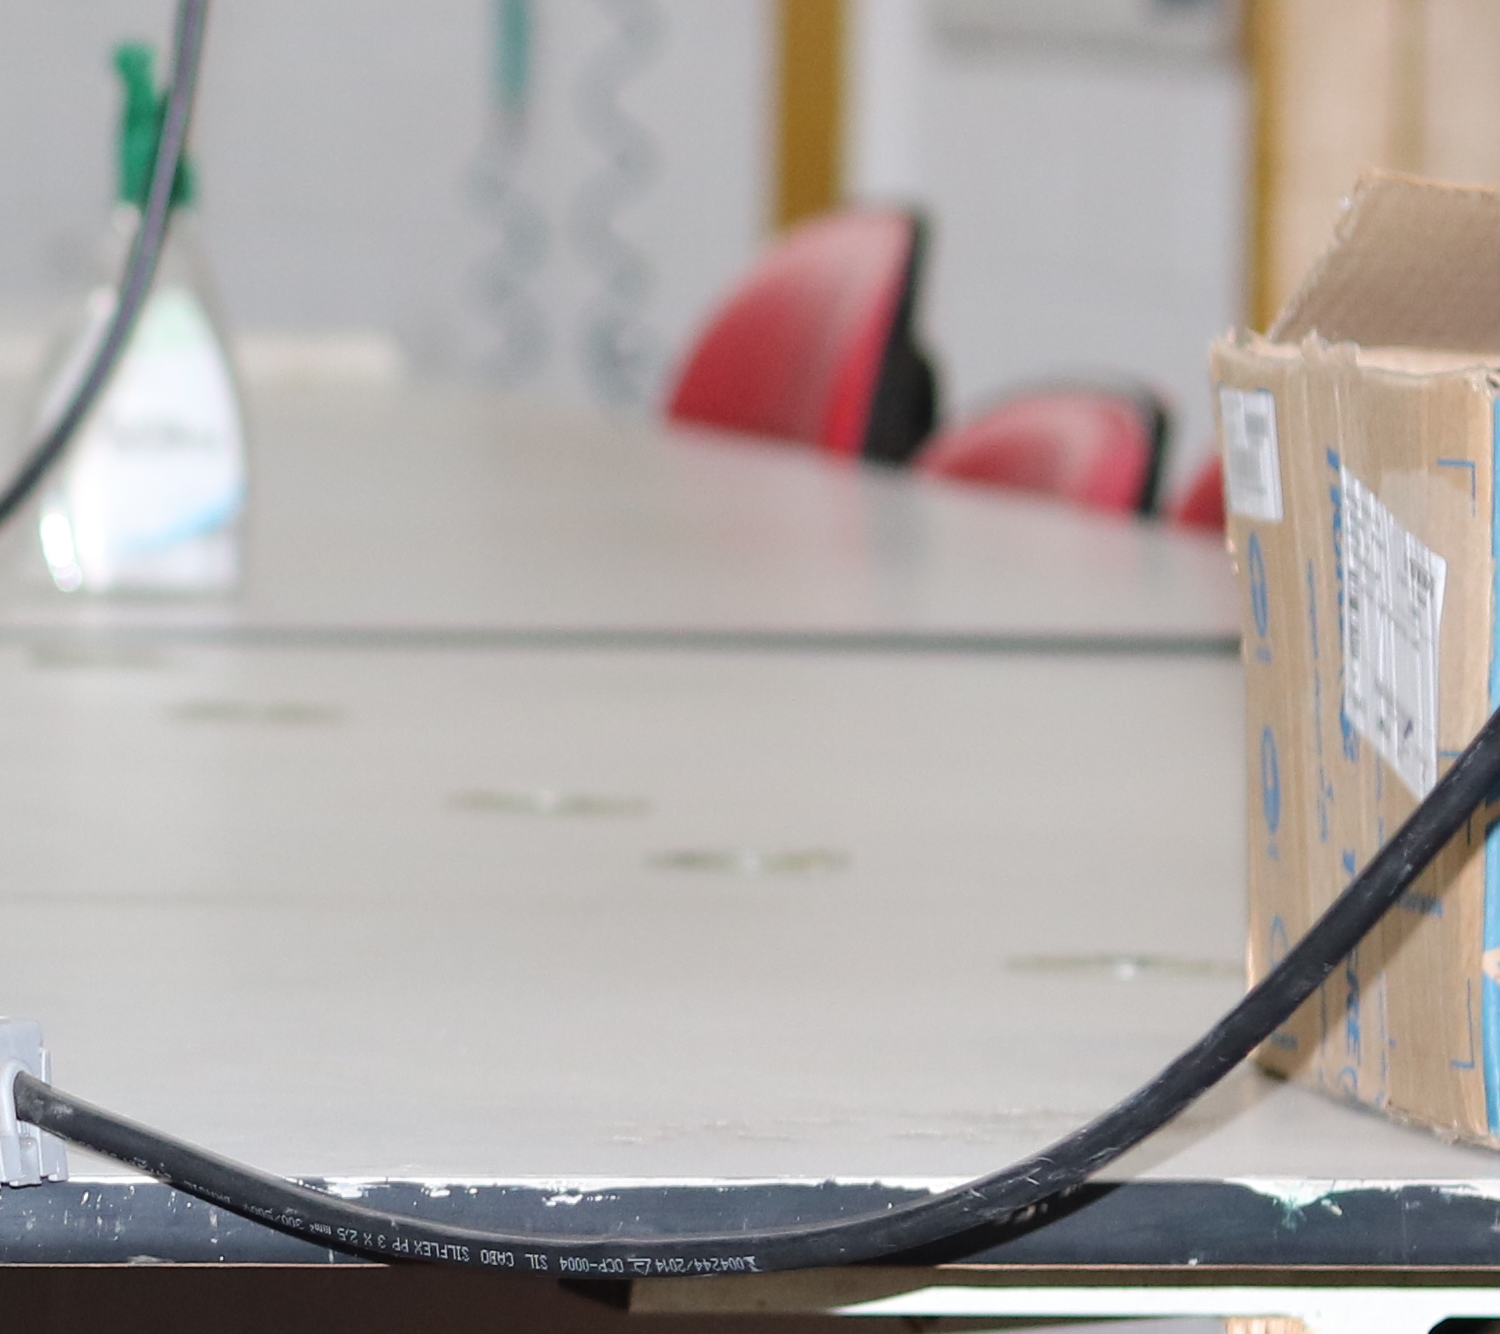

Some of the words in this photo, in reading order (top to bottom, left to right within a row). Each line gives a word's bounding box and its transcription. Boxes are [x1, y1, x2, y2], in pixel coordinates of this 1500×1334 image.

[336, 1227, 357, 1243] 2,5
[377, 1234, 387, 1248] 3
[392, 1237, 409, 1253] PP
[414, 1240, 470, 1262] SILFLEX
[480, 1248, 515, 1268] CABO
[525, 1253, 549, 1271] SIL
